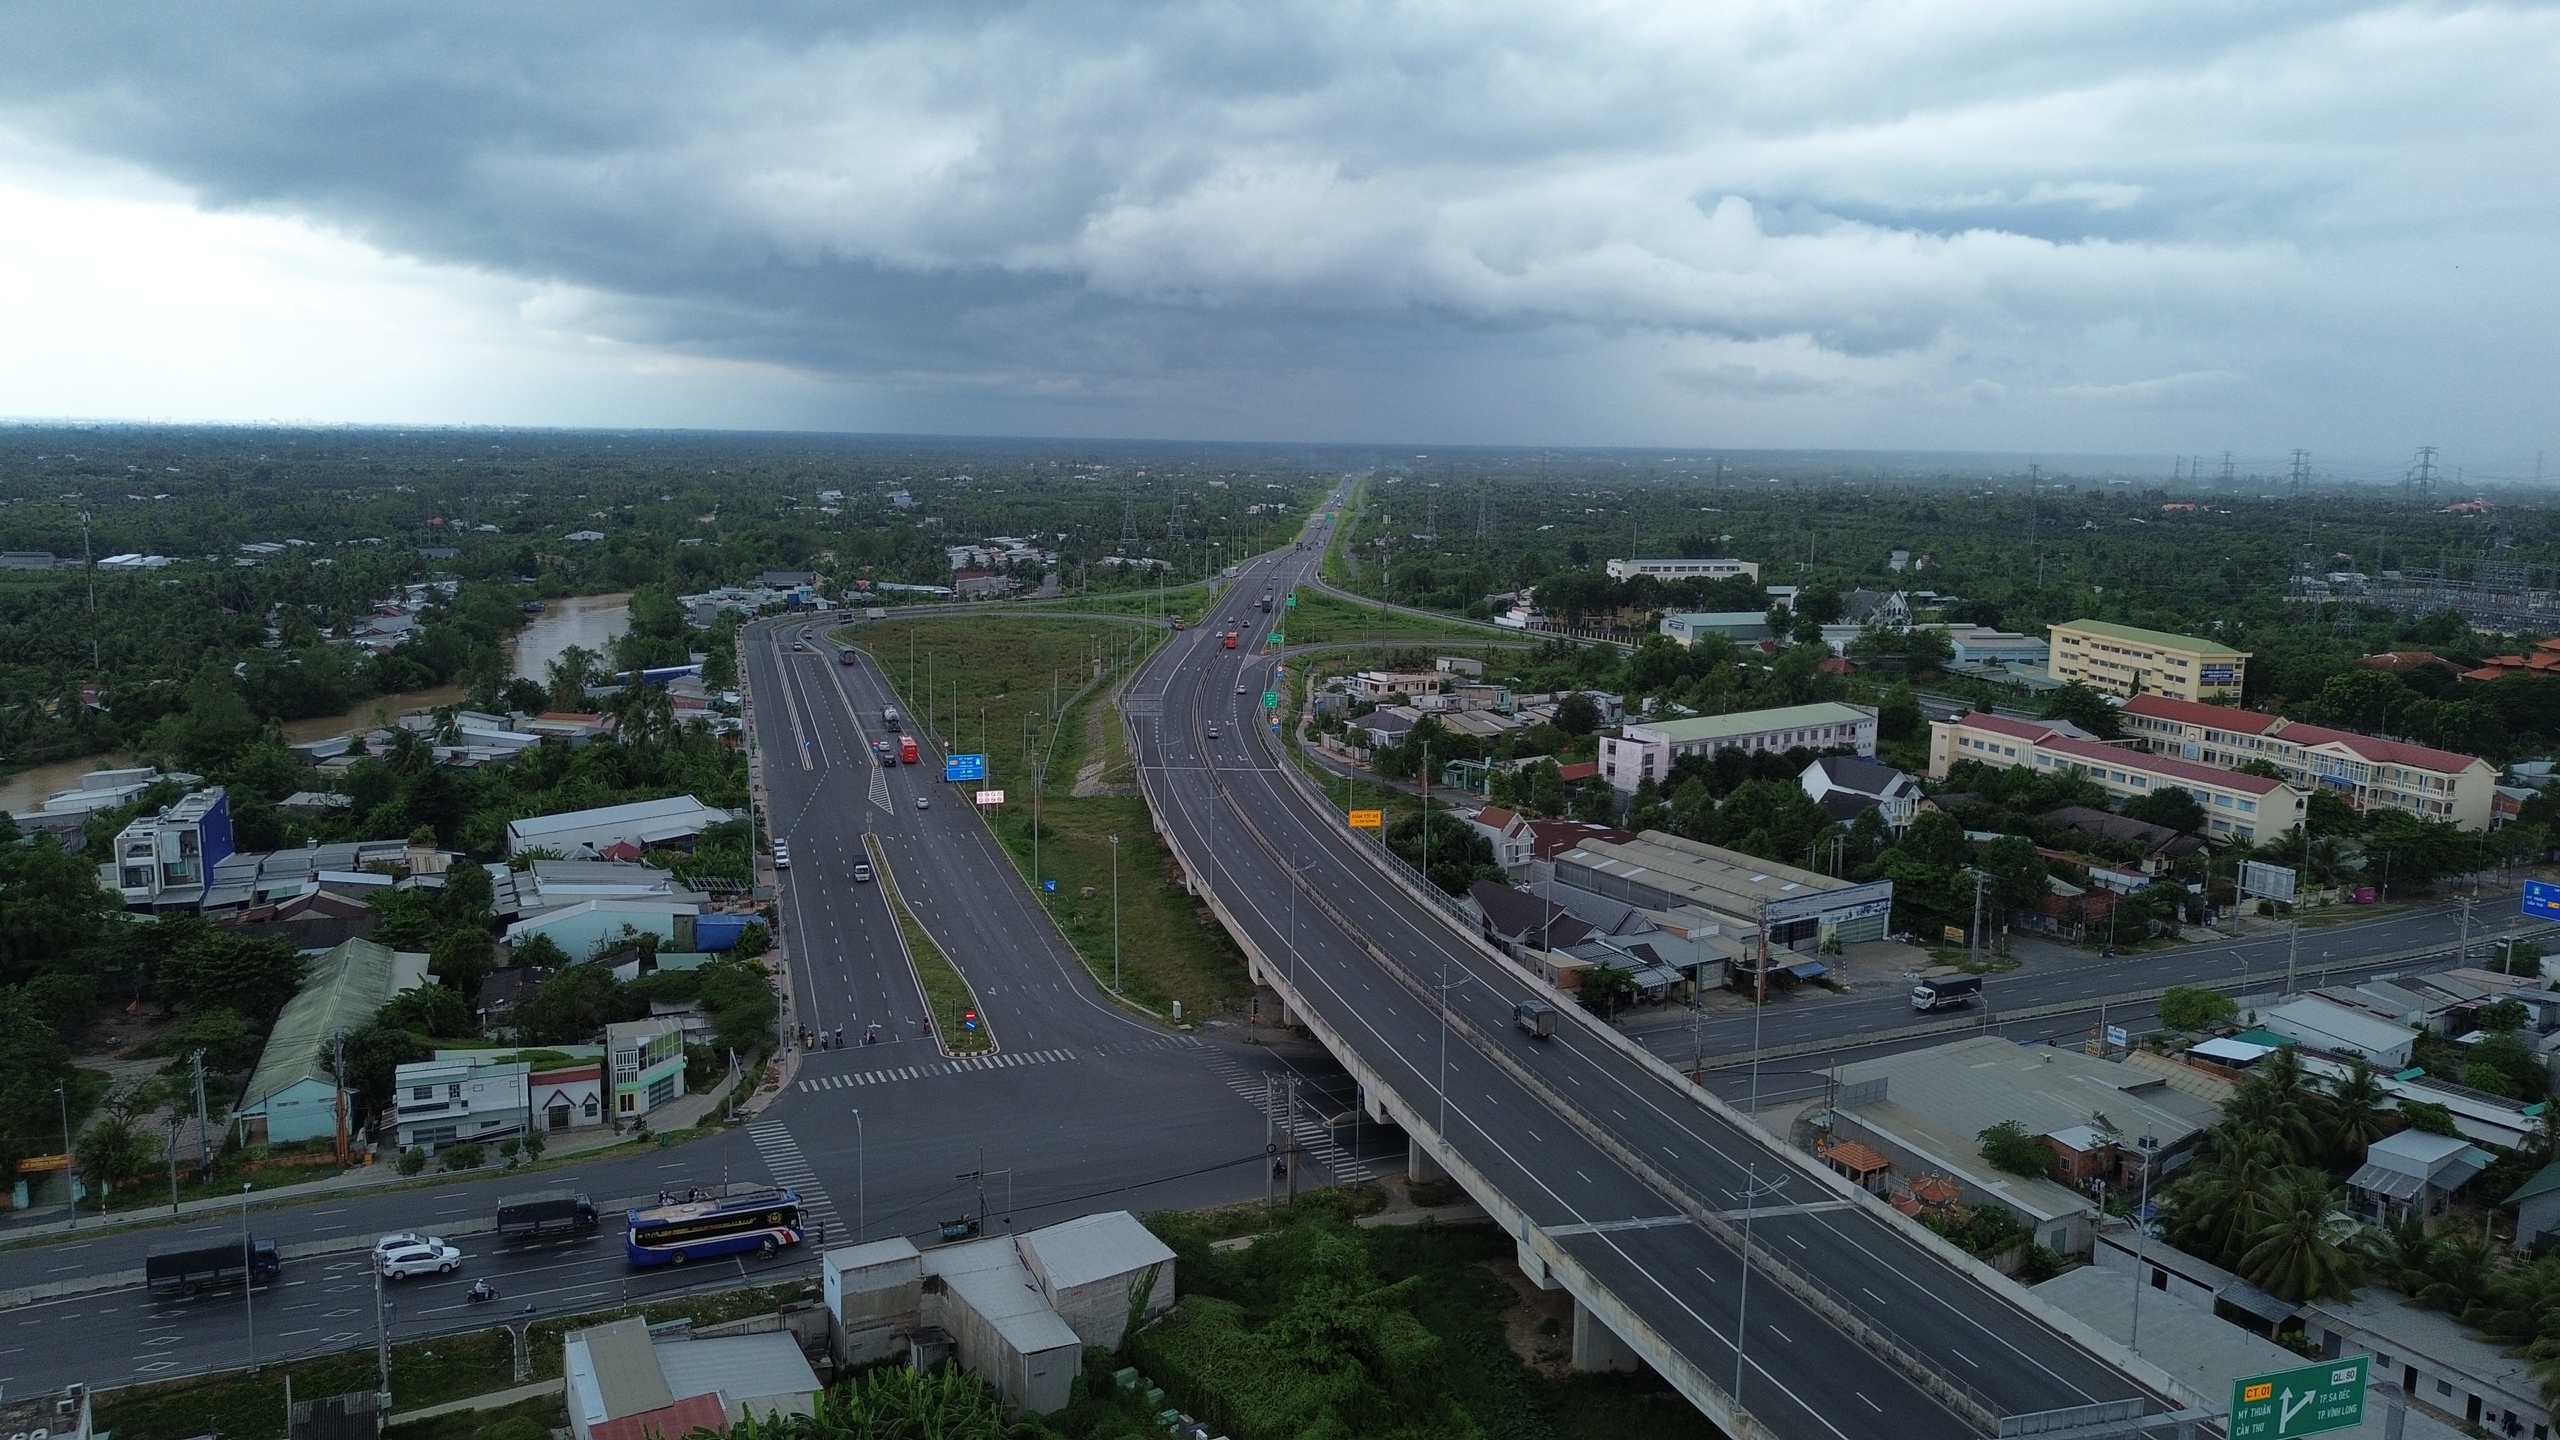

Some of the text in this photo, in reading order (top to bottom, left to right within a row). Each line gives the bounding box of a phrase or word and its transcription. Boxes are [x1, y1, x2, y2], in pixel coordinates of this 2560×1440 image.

[2246, 1386, 2270, 1398] CT.01
[2238, 1404, 2271, 1420] MỸ THUẬN
[2342, 1404, 2357, 1415] LONG
[2236, 1423, 2249, 1436] CẦN
